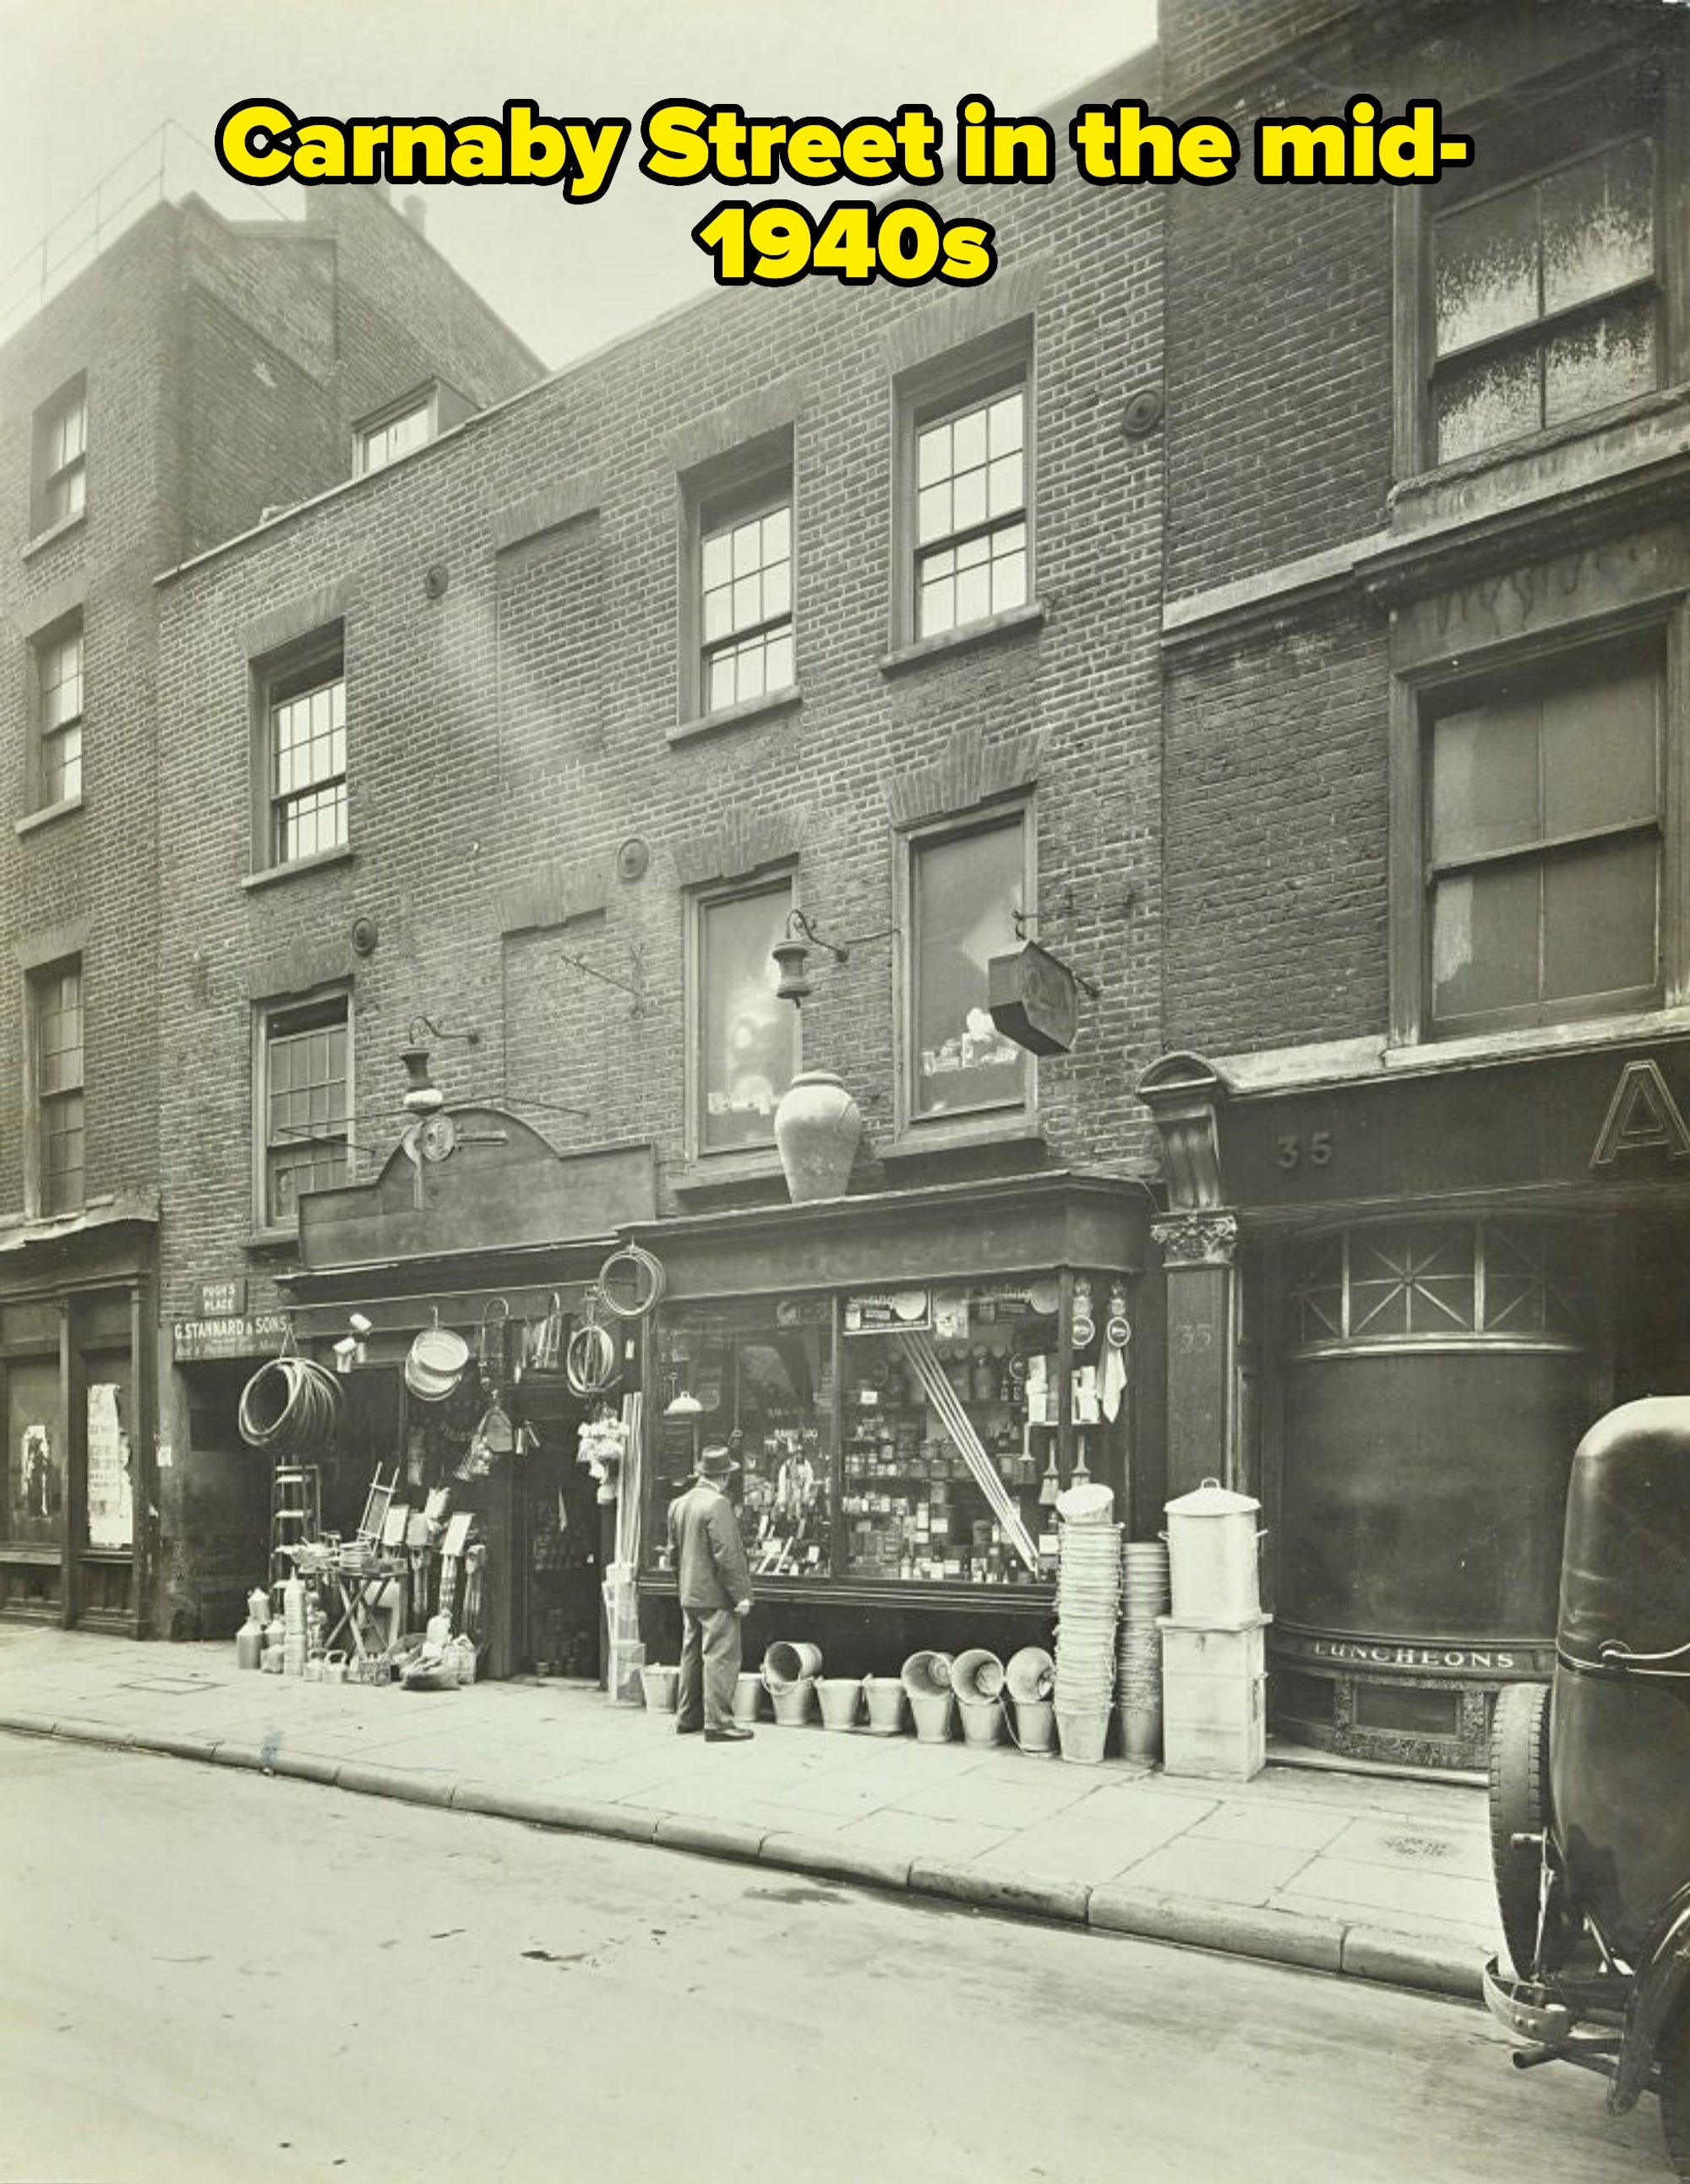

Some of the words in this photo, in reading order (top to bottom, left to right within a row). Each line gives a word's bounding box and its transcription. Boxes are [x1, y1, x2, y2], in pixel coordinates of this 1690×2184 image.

[1277, 1132, 1333, 1169] 35
[255, 1315, 286, 1333] SONS
[1180, 1321, 1213, 1353] 35
[1314, 1642, 1515, 1669] LUNCHEONS
